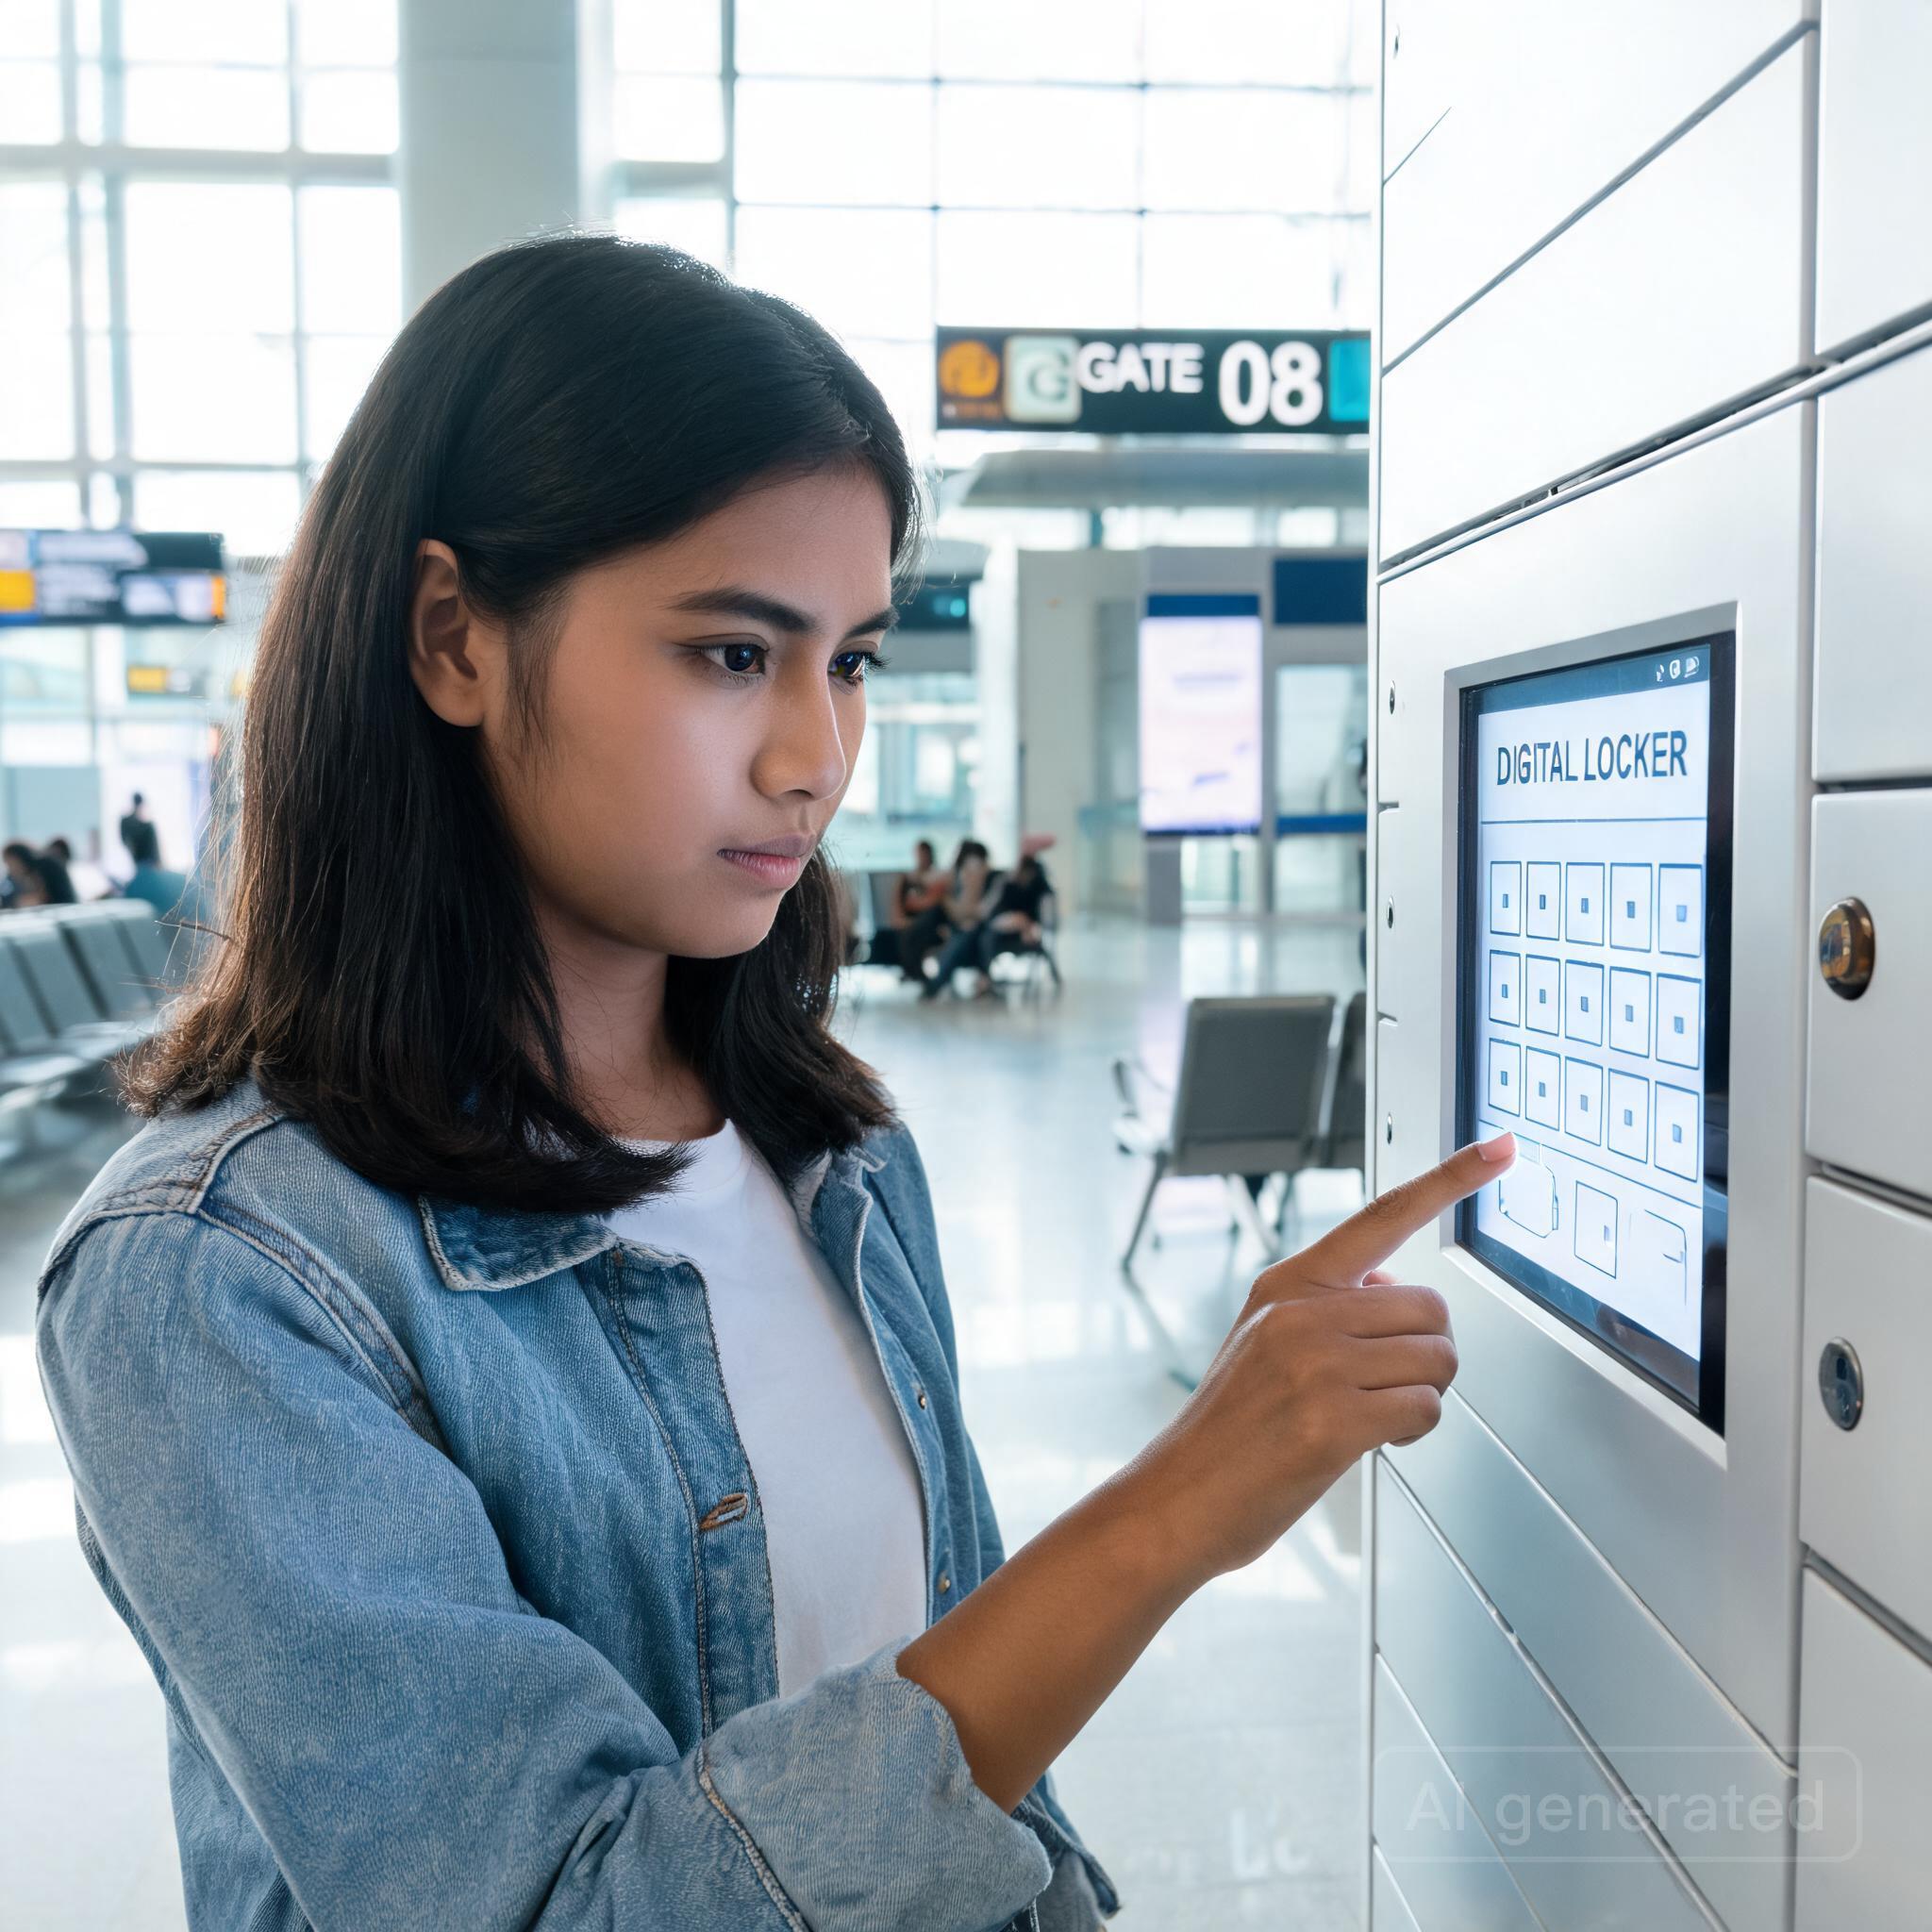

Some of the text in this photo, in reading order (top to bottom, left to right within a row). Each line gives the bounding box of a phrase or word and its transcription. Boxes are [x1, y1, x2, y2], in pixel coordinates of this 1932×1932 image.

[1076, 341, 1323, 425] GATE 08
[1497, 731, 1687, 785] DIGITAL LOCKER
